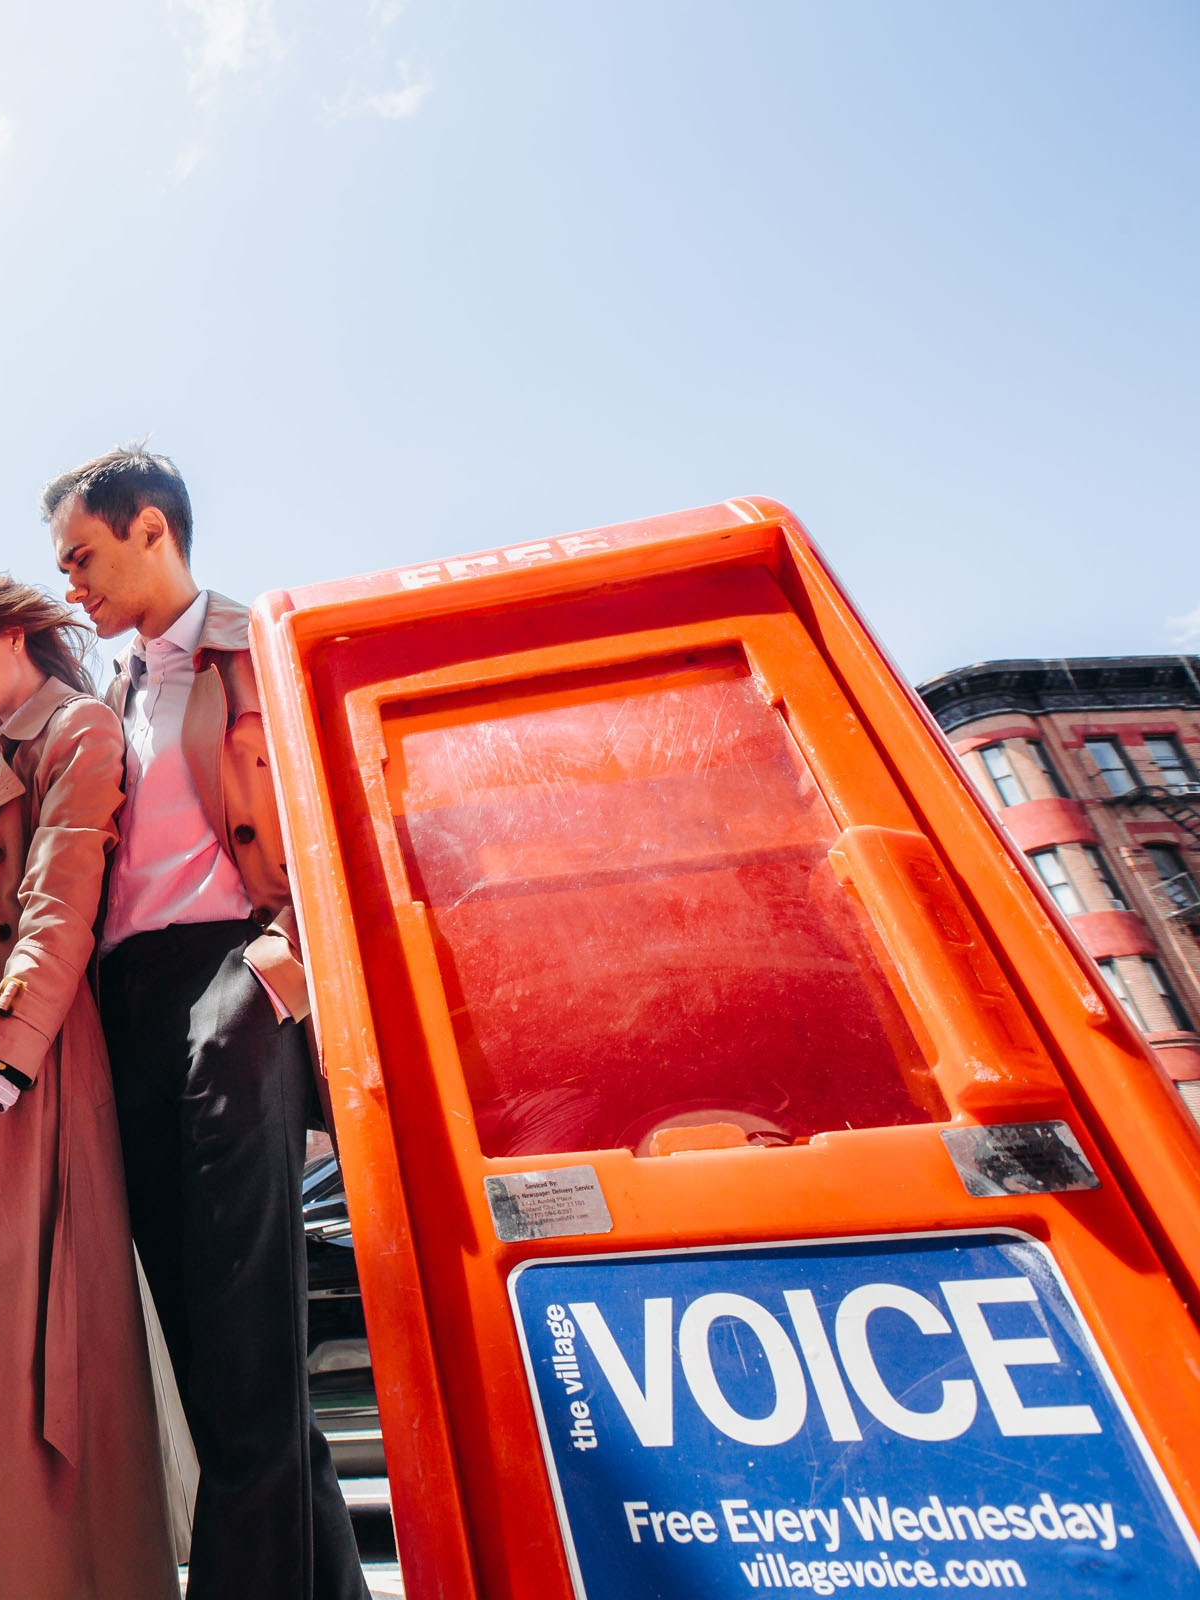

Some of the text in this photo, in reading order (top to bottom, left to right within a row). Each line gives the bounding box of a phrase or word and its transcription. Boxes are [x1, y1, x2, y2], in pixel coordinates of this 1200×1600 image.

[574, 1184, 595, 1192] Service
[546, 1304, 598, 1451] the village
[568, 1276, 1103, 1448] VOICE
[623, 1493, 1135, 1552] Free Every Wednesday.
[739, 1552, 1028, 1596] villagevoice.com
